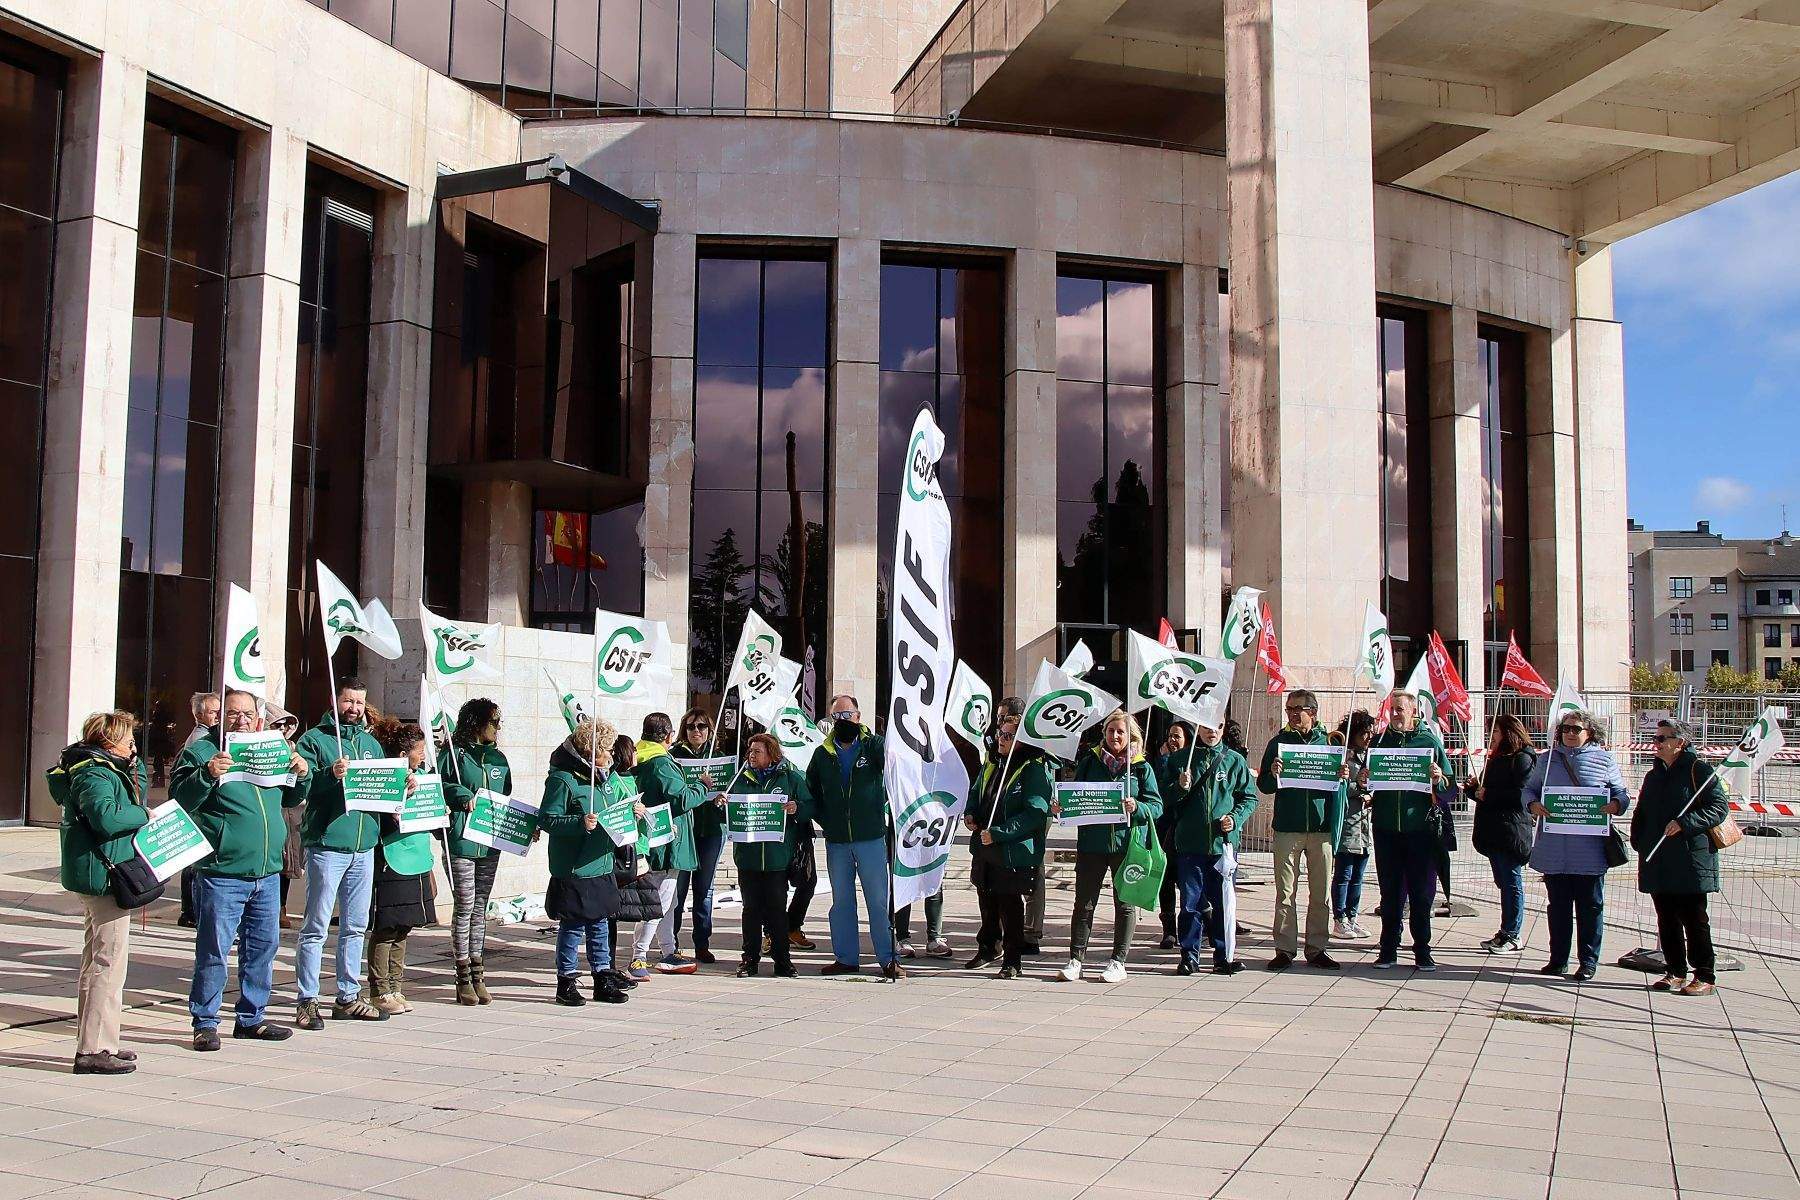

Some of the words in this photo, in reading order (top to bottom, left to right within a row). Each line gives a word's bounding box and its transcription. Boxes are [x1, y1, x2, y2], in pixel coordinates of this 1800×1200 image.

[604, 646, 652, 674] CSIF
[894, 529, 939, 763] CSIF
[748, 672, 776, 695] SIF
[902, 814, 960, 848] CSI
